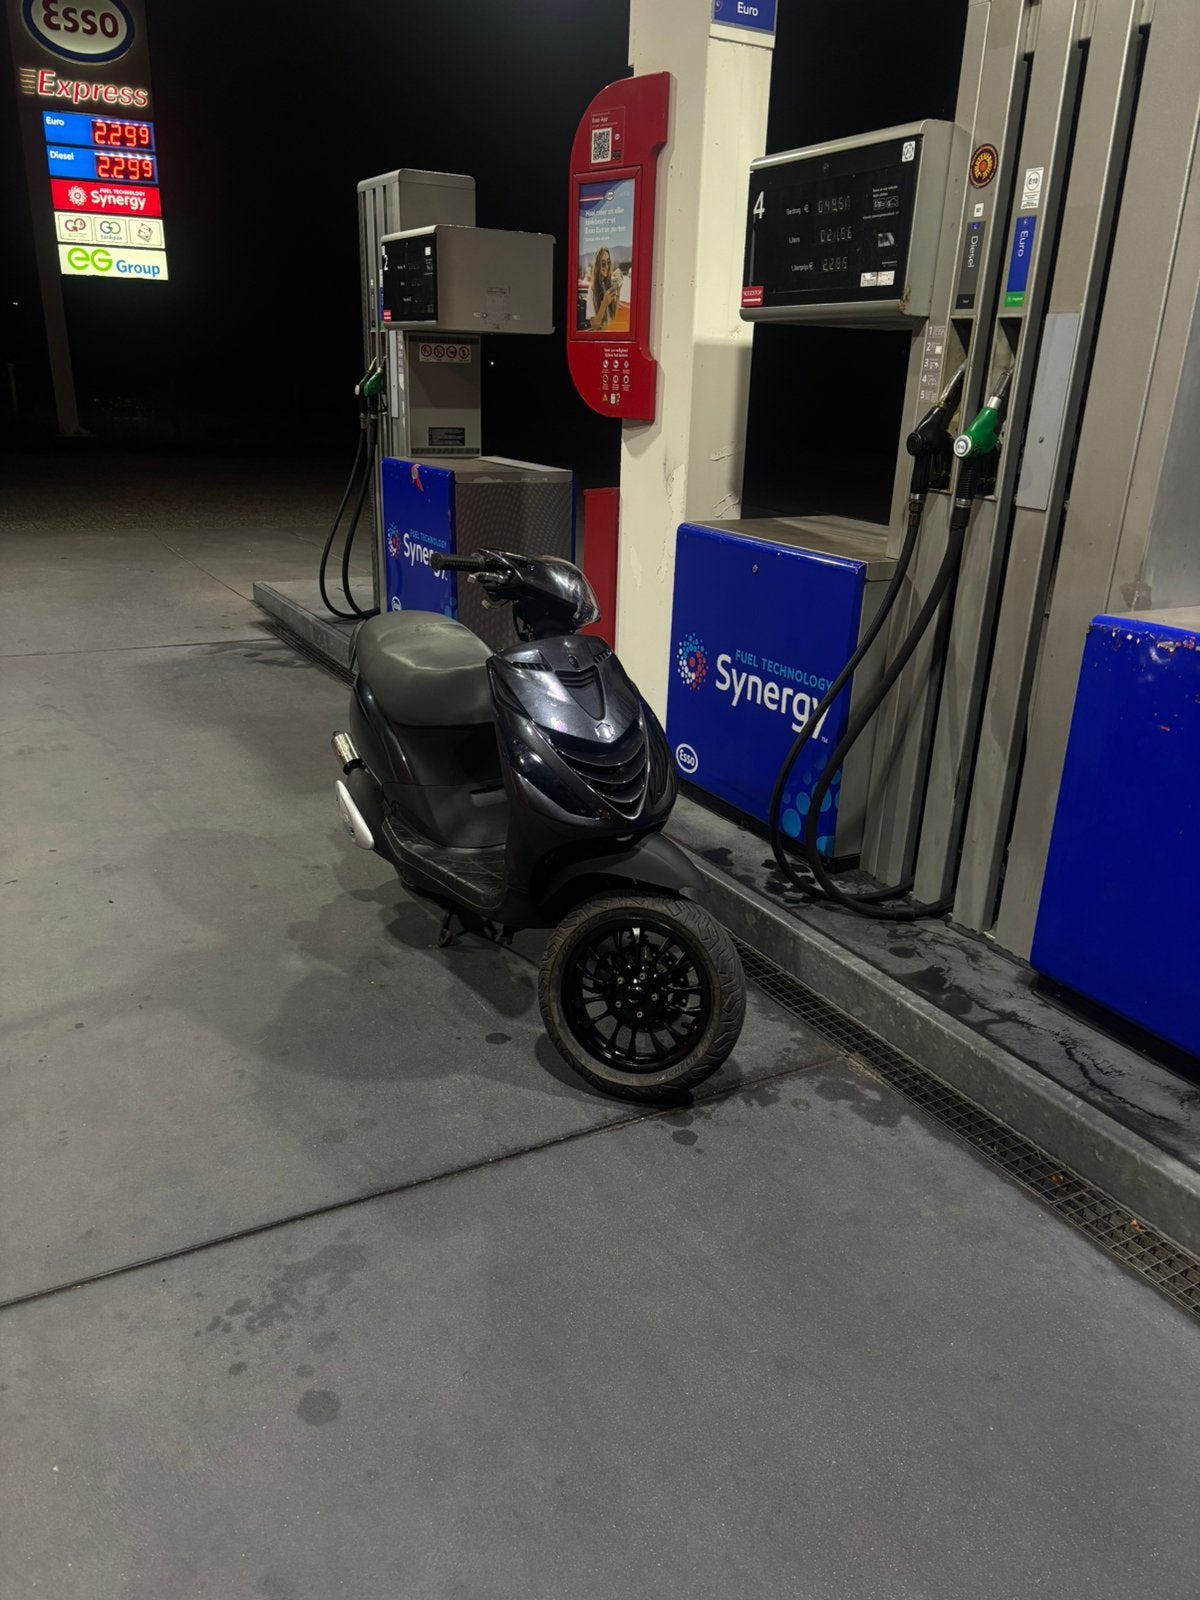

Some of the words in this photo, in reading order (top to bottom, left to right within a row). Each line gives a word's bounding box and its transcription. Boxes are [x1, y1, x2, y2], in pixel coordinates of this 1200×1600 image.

[737, 1, 759, 17] Euro
[37, 68, 148, 108] Express
[46, 116, 65, 126] Euro
[95, 122, 149, 147] 2.299
[49, 150, 74, 160] Diesel
[98, 156, 152, 180] 2.299
[1028, 177, 1038, 185] E10
[90, 190, 146, 211] Synergy
[753, 191, 765, 219] 4
[968, 236, 978, 268] Diesel
[1018, 230, 1028, 256] Euro
[116, 259, 160, 278] Group
[928, 326, 933, 336] 1
[926, 342, 932, 352] 2
[924, 358, 929, 368] 3
[922, 374, 927, 383] 4
[920, 390, 925, 399] 5
[403, 533, 447, 580] Syner
[735, 649, 759, 668] FUEL
[761, 658, 834, 692] TECHNOLOGY
[680, 749, 695, 766] Esso
